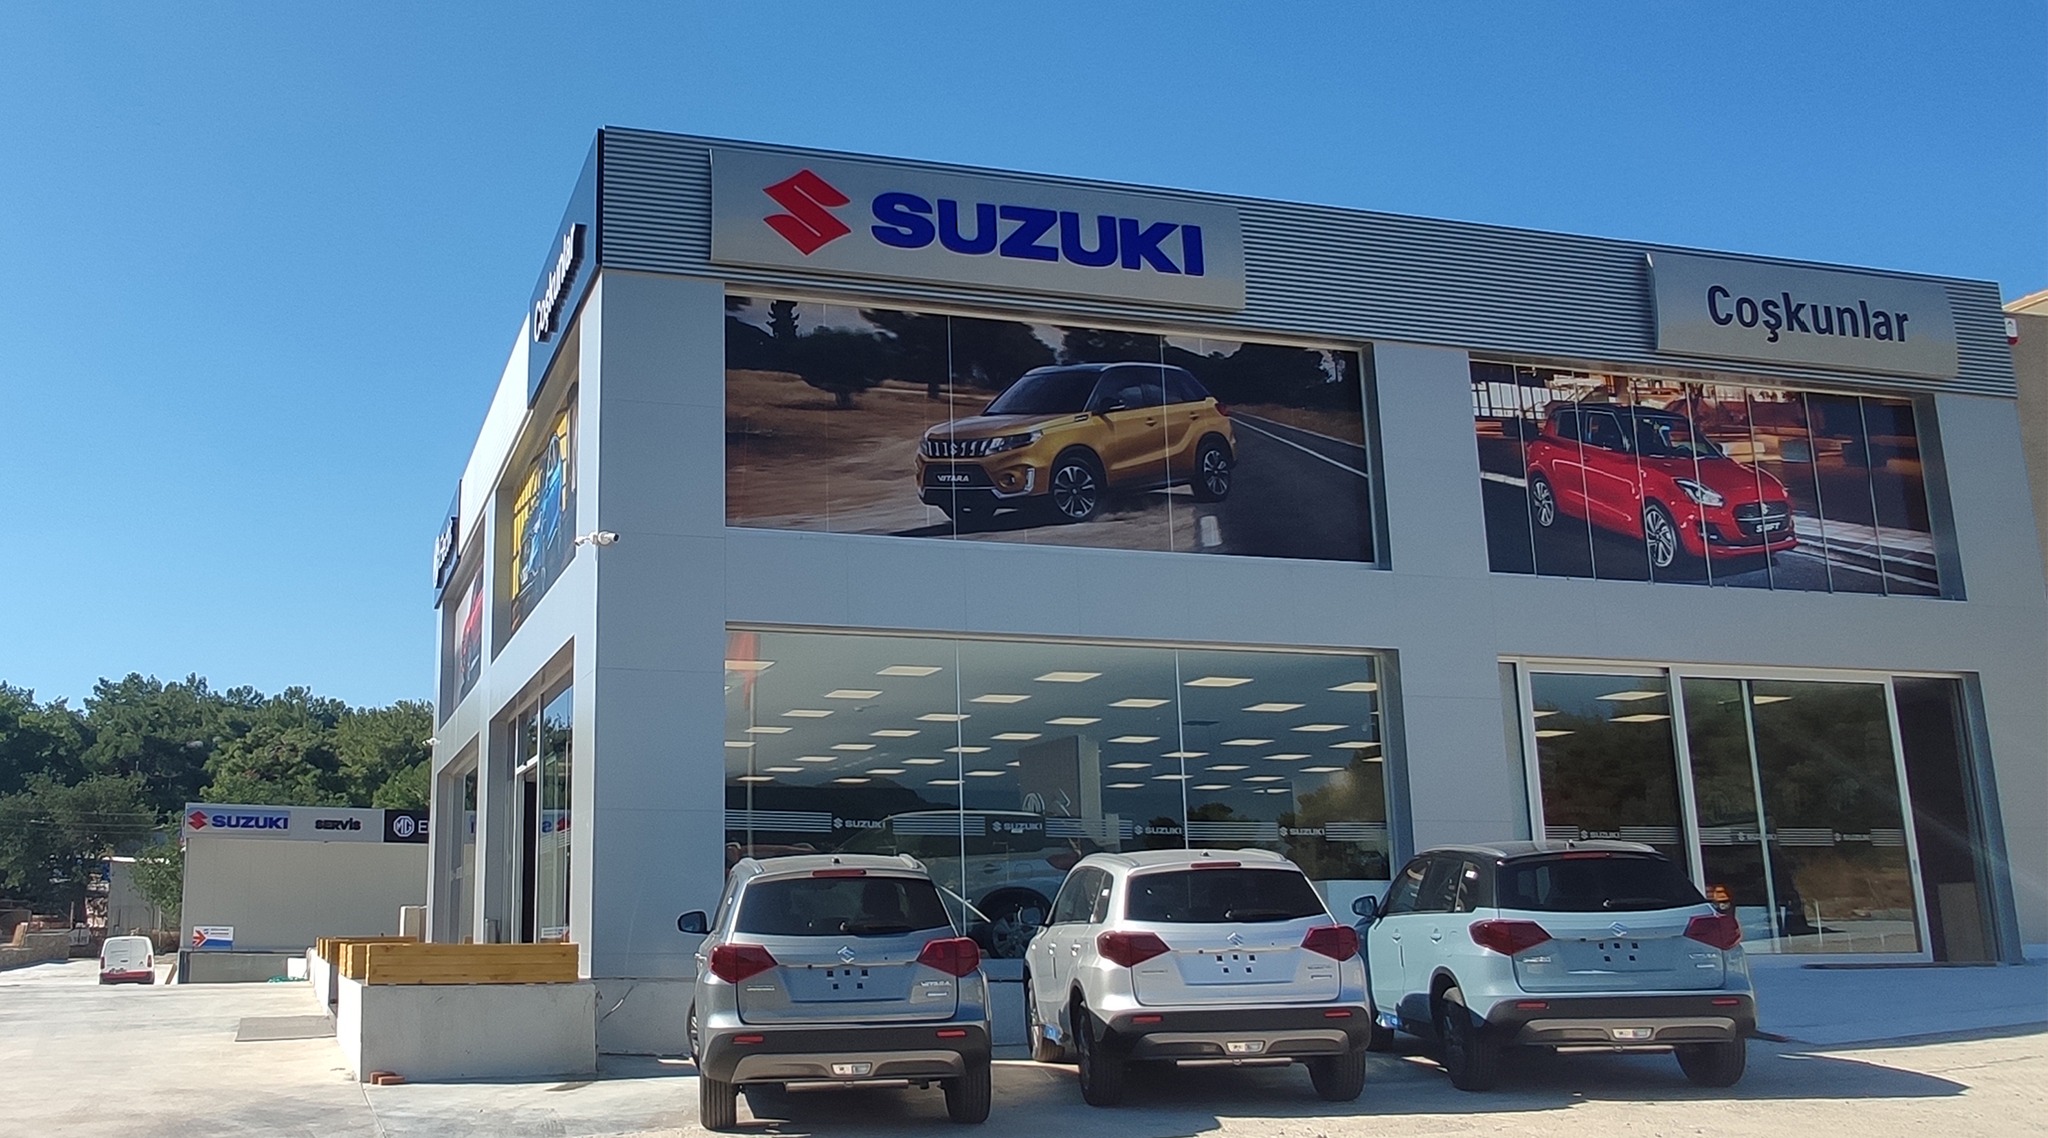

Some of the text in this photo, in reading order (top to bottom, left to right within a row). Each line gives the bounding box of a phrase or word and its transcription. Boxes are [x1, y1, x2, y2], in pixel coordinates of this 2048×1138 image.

[870, 191, 1205, 276] SUZUKI
[1706, 285, 1909, 342] Coşkunlar
[211, 815, 288, 829] SUZUKI
[845, 819, 886, 829] SUZUKI
[1004, 822, 1043, 830] SUZUKI
[1145, 826, 1182, 835] SUZUKI
[1289, 828, 1325, 836] SUZUKI
